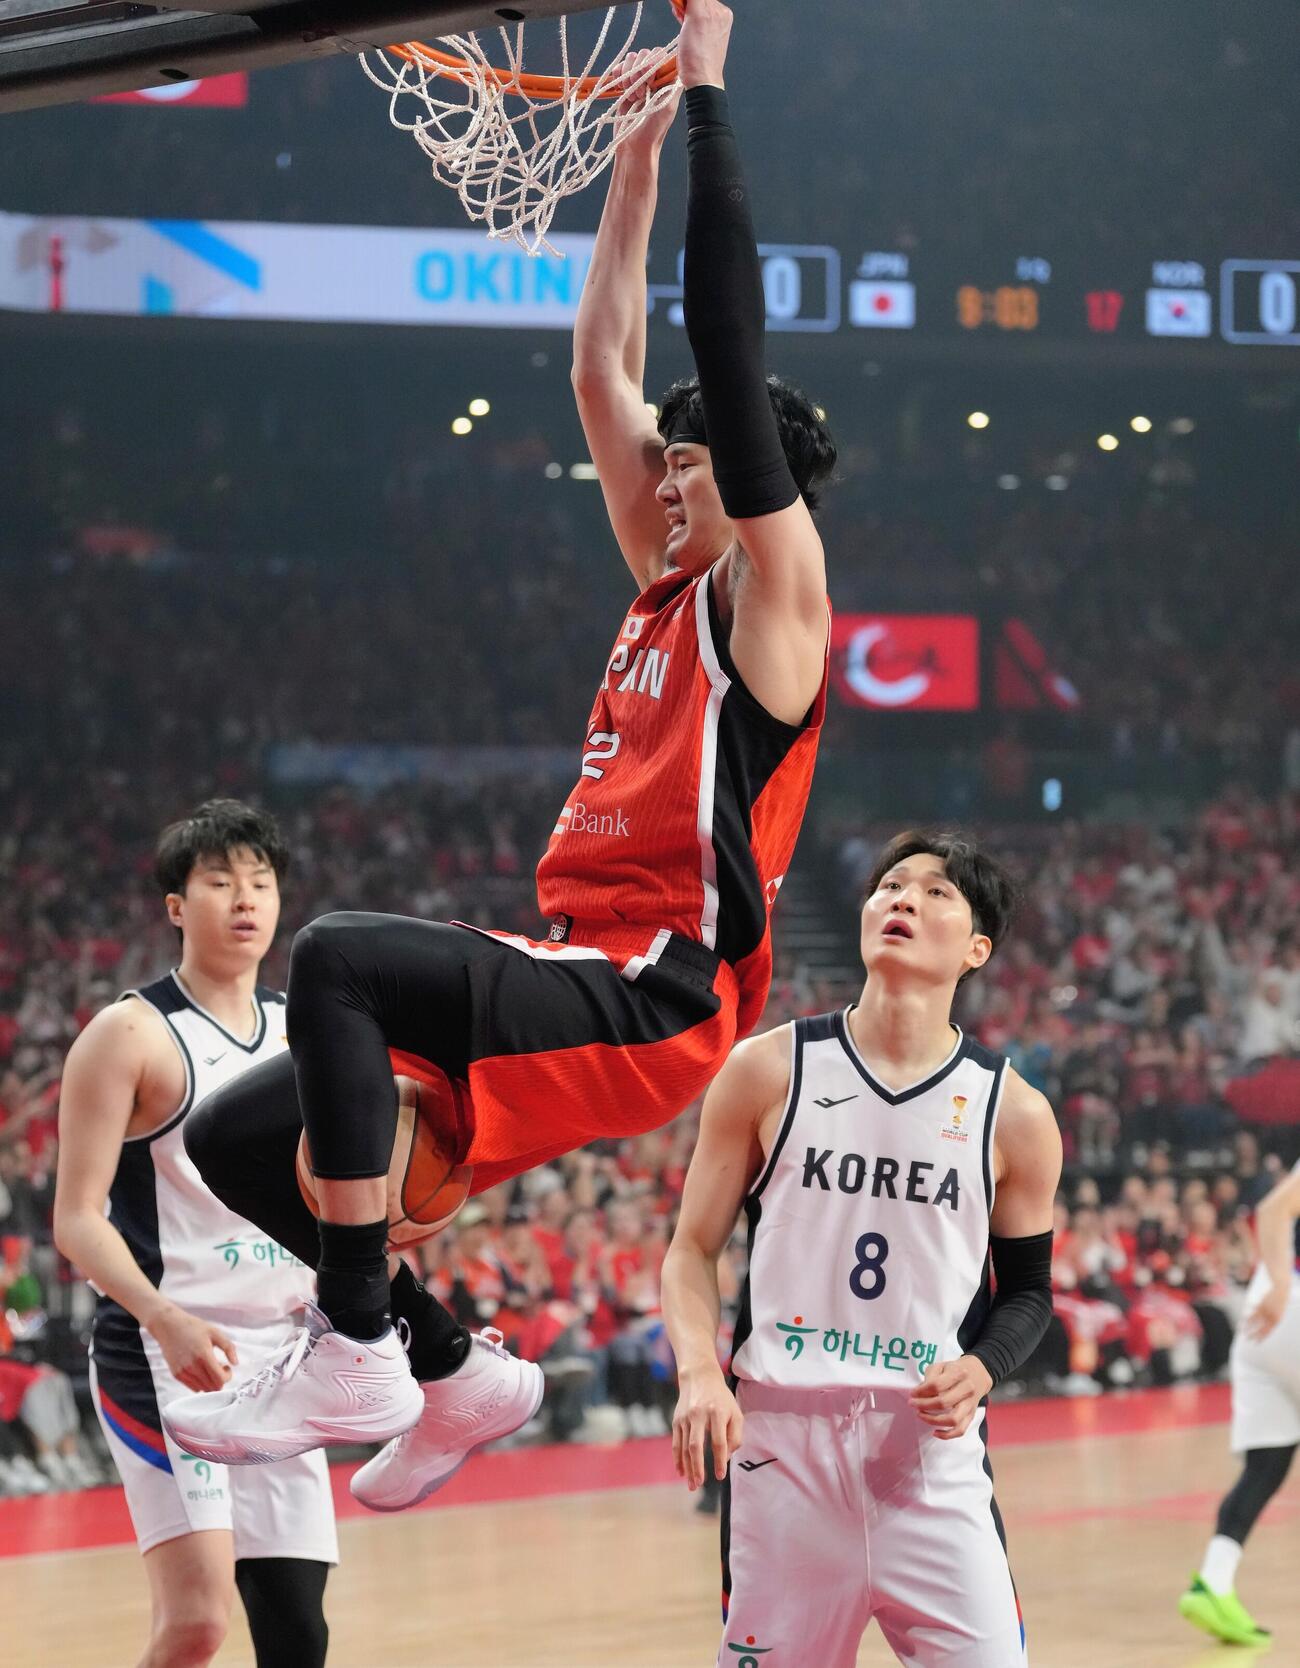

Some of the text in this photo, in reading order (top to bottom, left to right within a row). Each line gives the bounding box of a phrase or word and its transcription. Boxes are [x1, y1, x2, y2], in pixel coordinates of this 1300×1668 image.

[416, 249, 591, 304] OKIN
[763, 255, 800, 320] 0
[1259, 270, 1295, 335] 0
[1085, 291, 1123, 332] 17
[600, 644, 670, 700] PAN
[582, 721, 620, 780] 2
[802, 1147, 960, 1211] KOREA
[849, 1232, 888, 1300] 8
[823, 1328, 938, 1376] 하나은행
